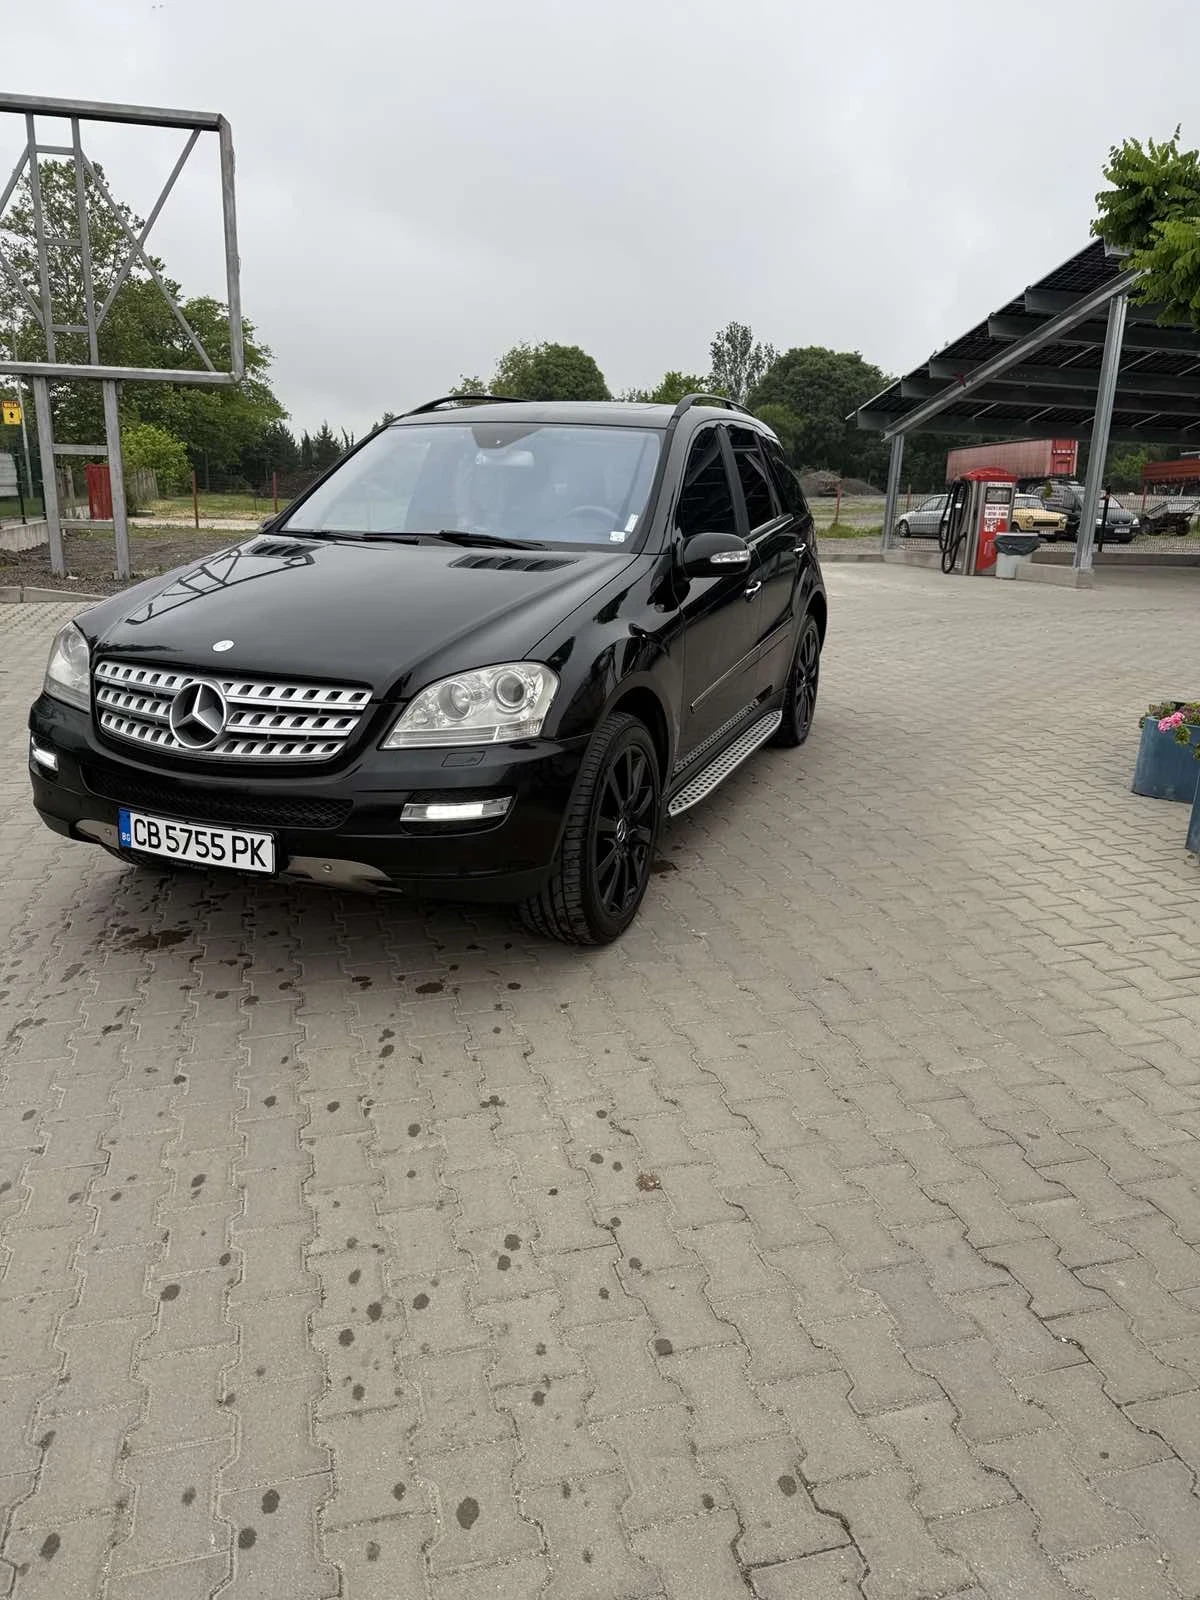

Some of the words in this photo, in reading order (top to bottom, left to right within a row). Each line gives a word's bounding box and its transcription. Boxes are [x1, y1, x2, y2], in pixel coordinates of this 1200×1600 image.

[121, 832, 130, 842] BG
[133, 818, 161, 849] CB
[165, 825, 226, 860] 5755
[231, 835, 267, 867] PK
